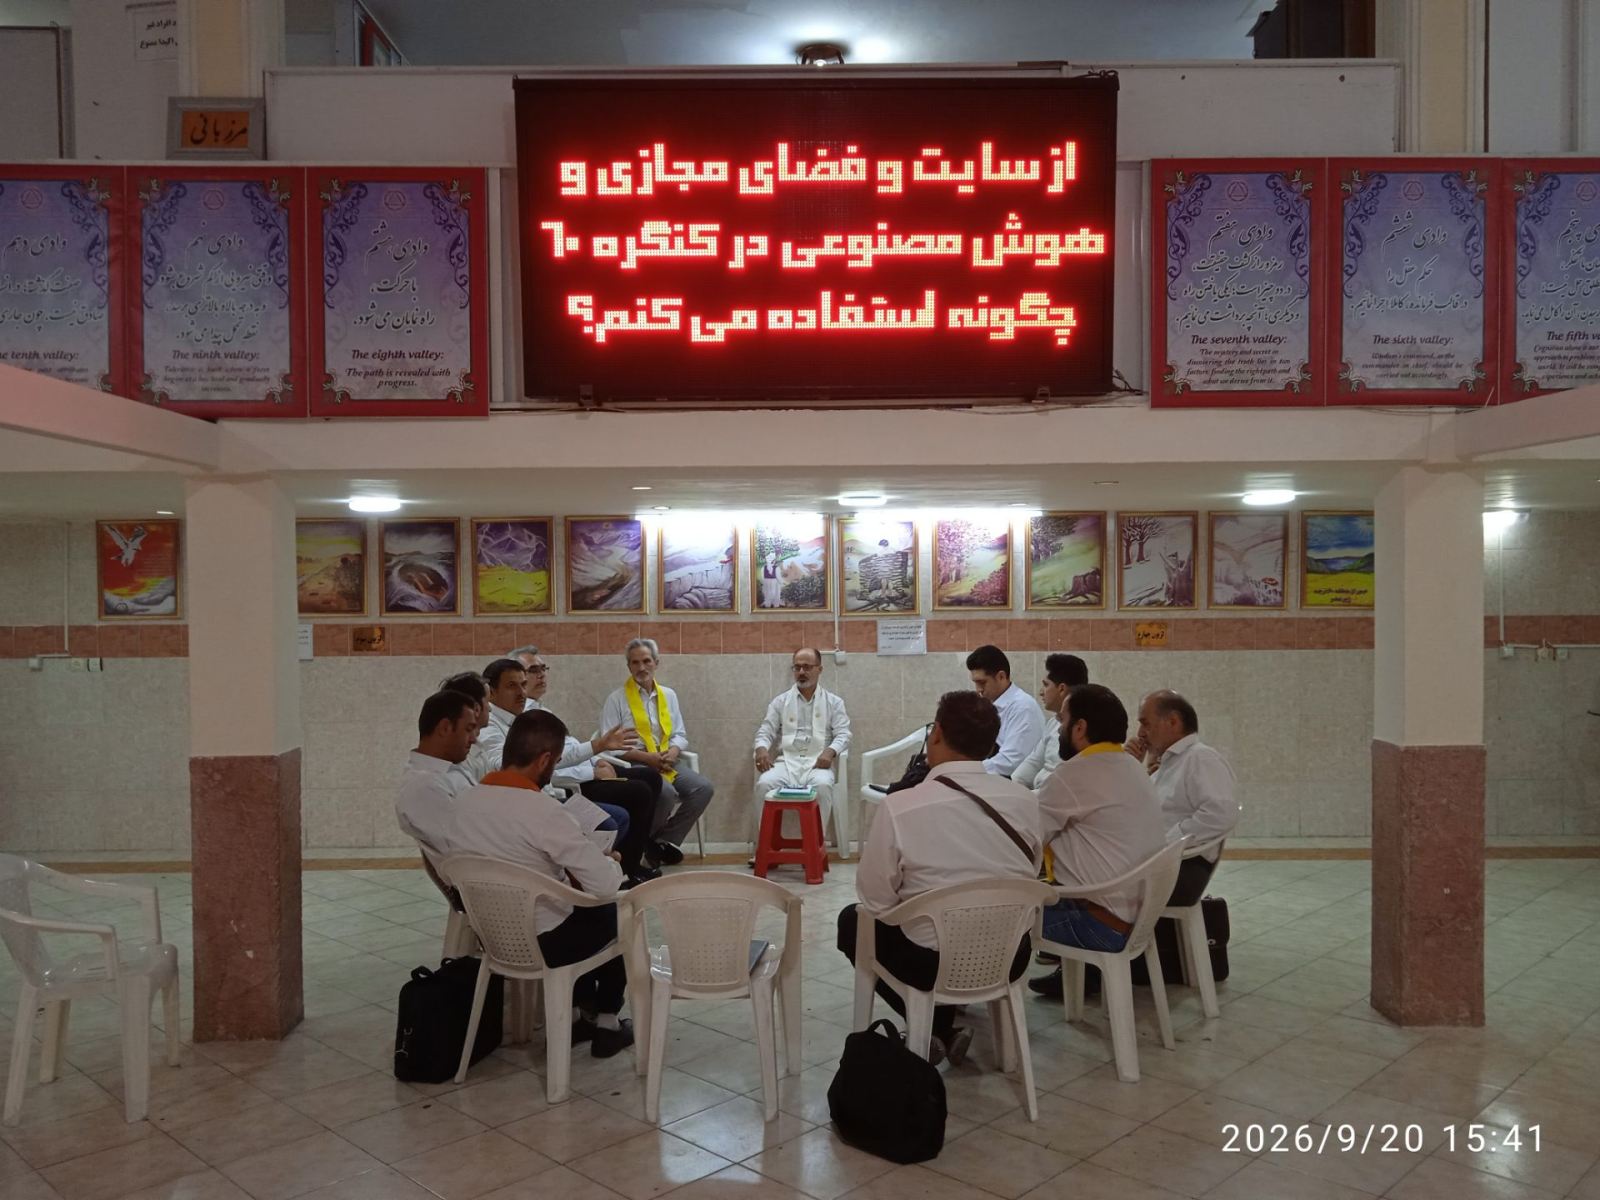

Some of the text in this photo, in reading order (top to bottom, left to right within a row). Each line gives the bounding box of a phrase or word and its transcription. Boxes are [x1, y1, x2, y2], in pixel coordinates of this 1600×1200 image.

[560, 141, 1077, 196] از سایت و فضای مجازی و
[592, 221, 720, 269] کنگره
[782, 222, 962, 268] مصنوعی
[972, 213, 1104, 266] هوش
[1239, 225, 1273, 246] وادی
[1413, 227, 1447, 248] وادی
[393, 240, 428, 261] وادی
[728, 235, 769, 269] در
[568, 290, 1076, 345] چگونه استفاده می کنم؟
[1191, 334, 1287, 345] The seventh valley:
[1373, 335, 1454, 346] The sixth valley:
[1547, 331, 1563, 340] The
[1566, 331, 1589, 341] fifth
[11, 349, 39, 360] tenth
[172, 350, 260, 361] The ninth valley:
[352, 349, 444, 361] The eighth valley:
[345, 368, 363, 377] The
[363, 368, 384, 379] path
